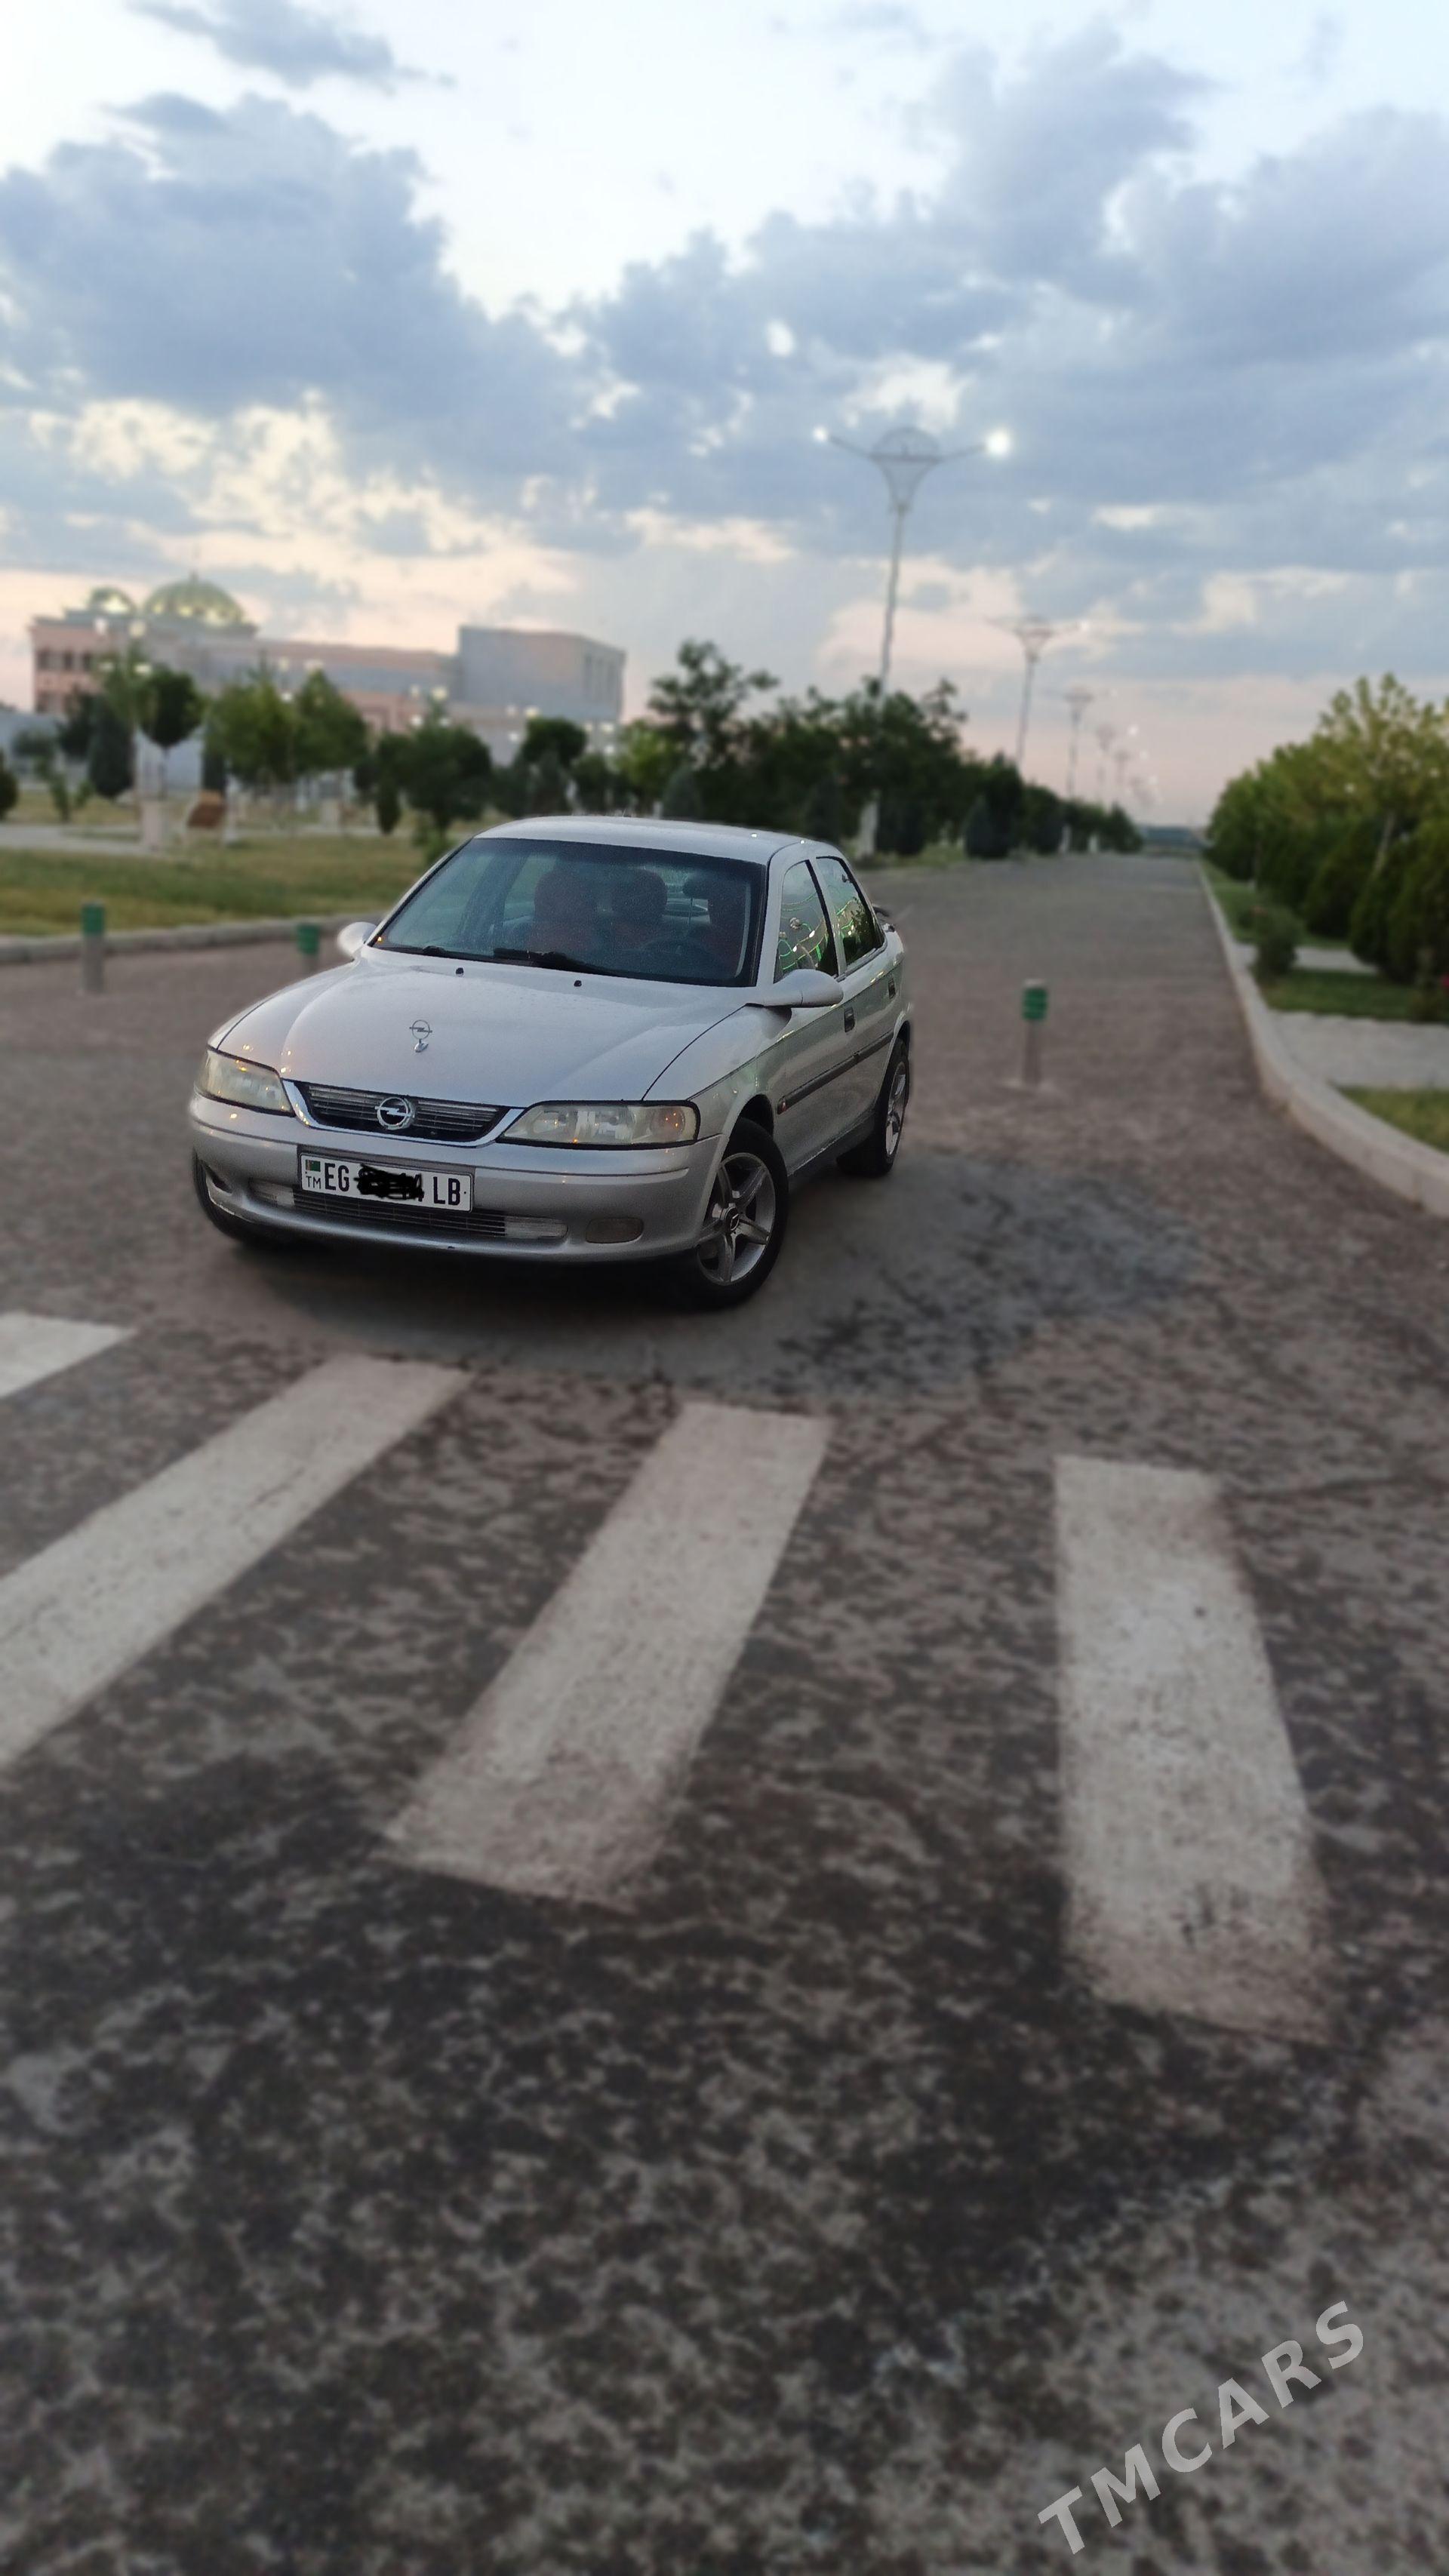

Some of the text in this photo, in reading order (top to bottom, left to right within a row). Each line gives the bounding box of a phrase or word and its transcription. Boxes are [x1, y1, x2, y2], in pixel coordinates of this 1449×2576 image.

[306, 1176, 321, 1190] TM
[325, 1163, 349, 1192] EG
[433, 1176, 461, 1206] LB
